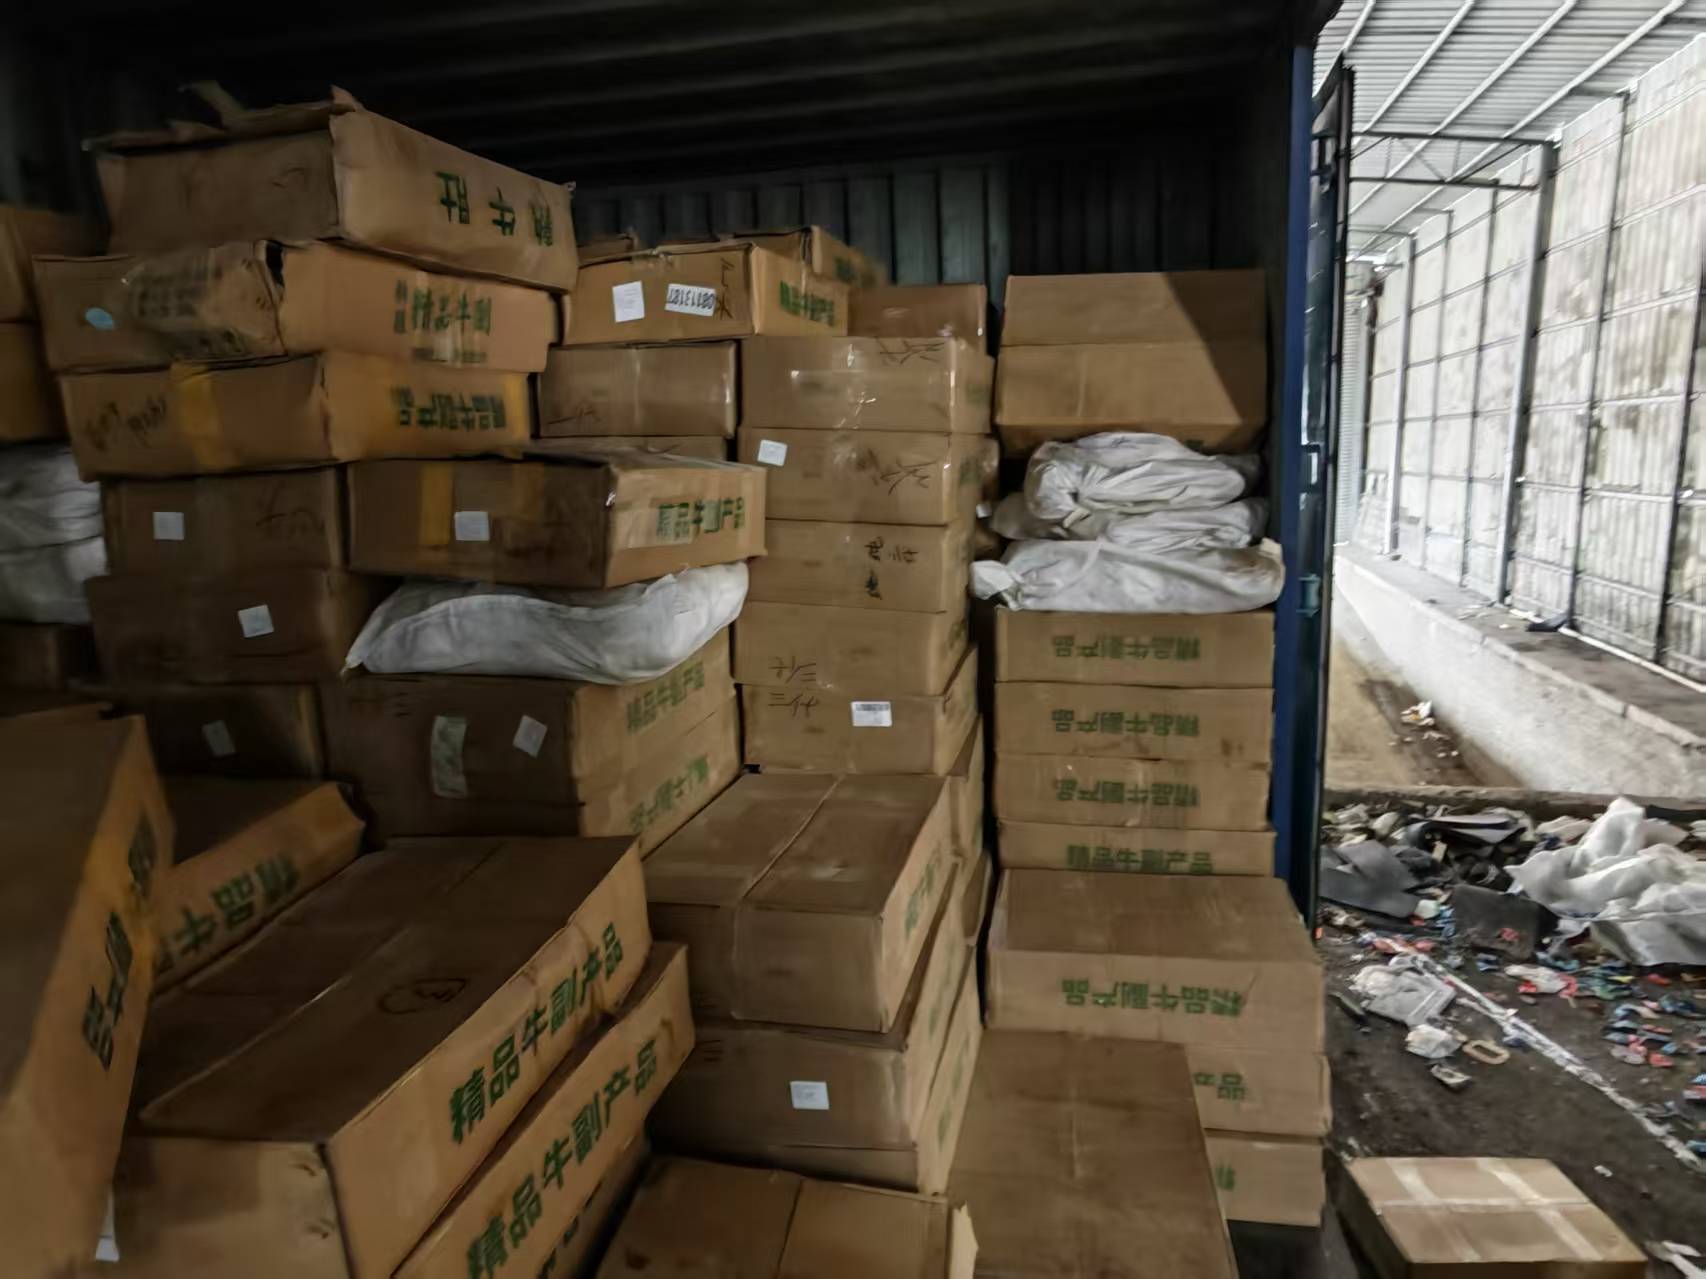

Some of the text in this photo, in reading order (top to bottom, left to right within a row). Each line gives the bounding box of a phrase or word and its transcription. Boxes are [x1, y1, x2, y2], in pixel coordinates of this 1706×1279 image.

[449, 921, 624, 1143] 精品牛副产品
[1061, 978, 1243, 1017] 精品牛副产品
